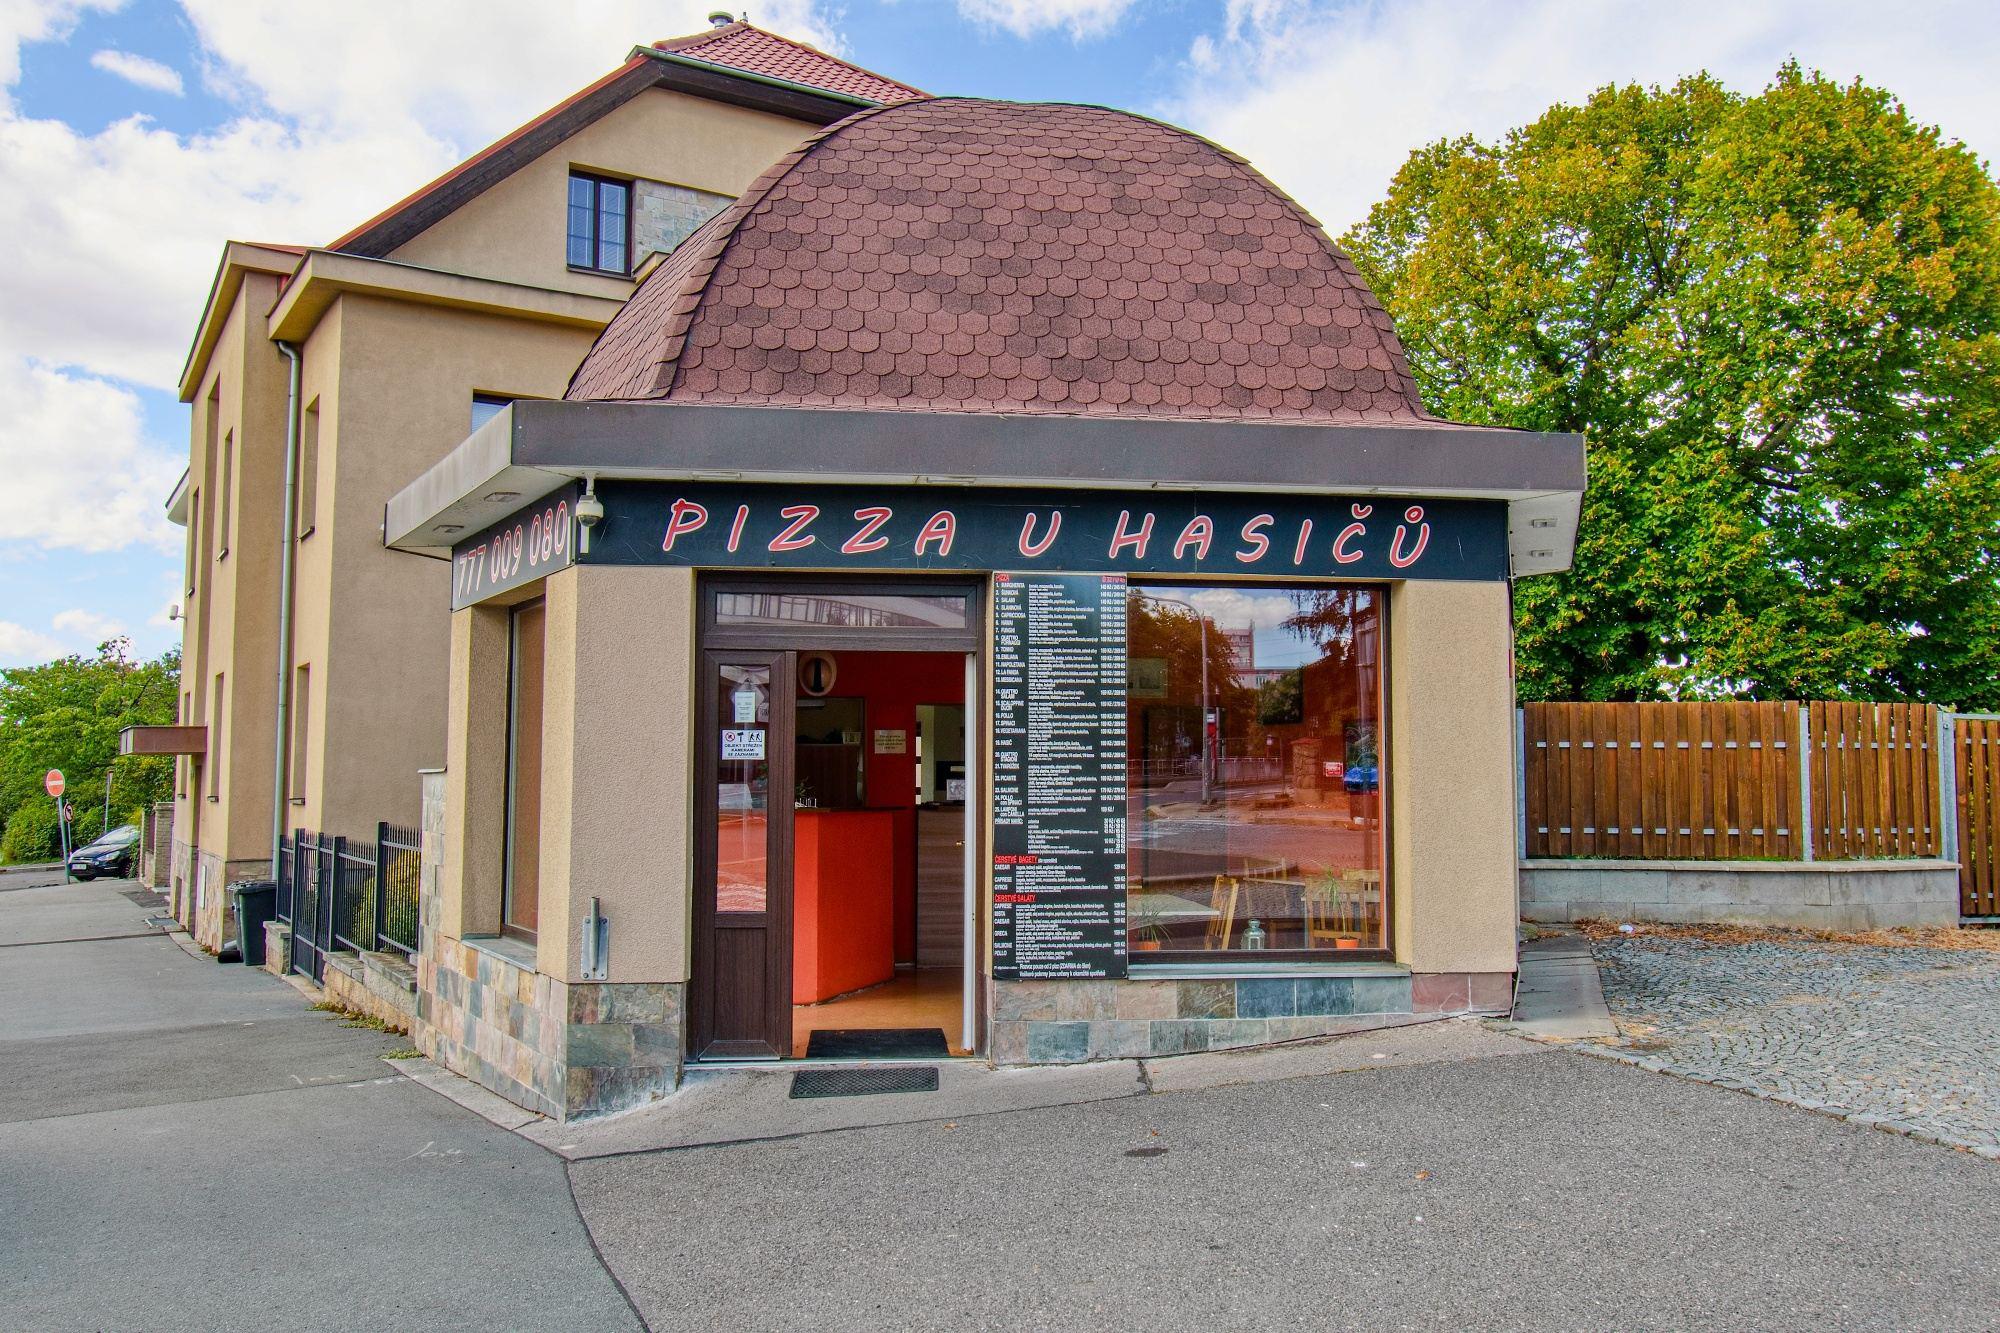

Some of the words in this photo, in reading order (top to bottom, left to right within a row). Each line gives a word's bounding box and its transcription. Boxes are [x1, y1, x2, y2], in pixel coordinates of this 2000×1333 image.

[459, 544, 487, 598] 777
[491, 524, 522, 584] 009
[530, 500, 568, 566] 080
[662, 498, 956, 556] PIZZA
[1018, 511, 1061, 557] U
[1109, 503, 1430, 568] HASIČŮ
